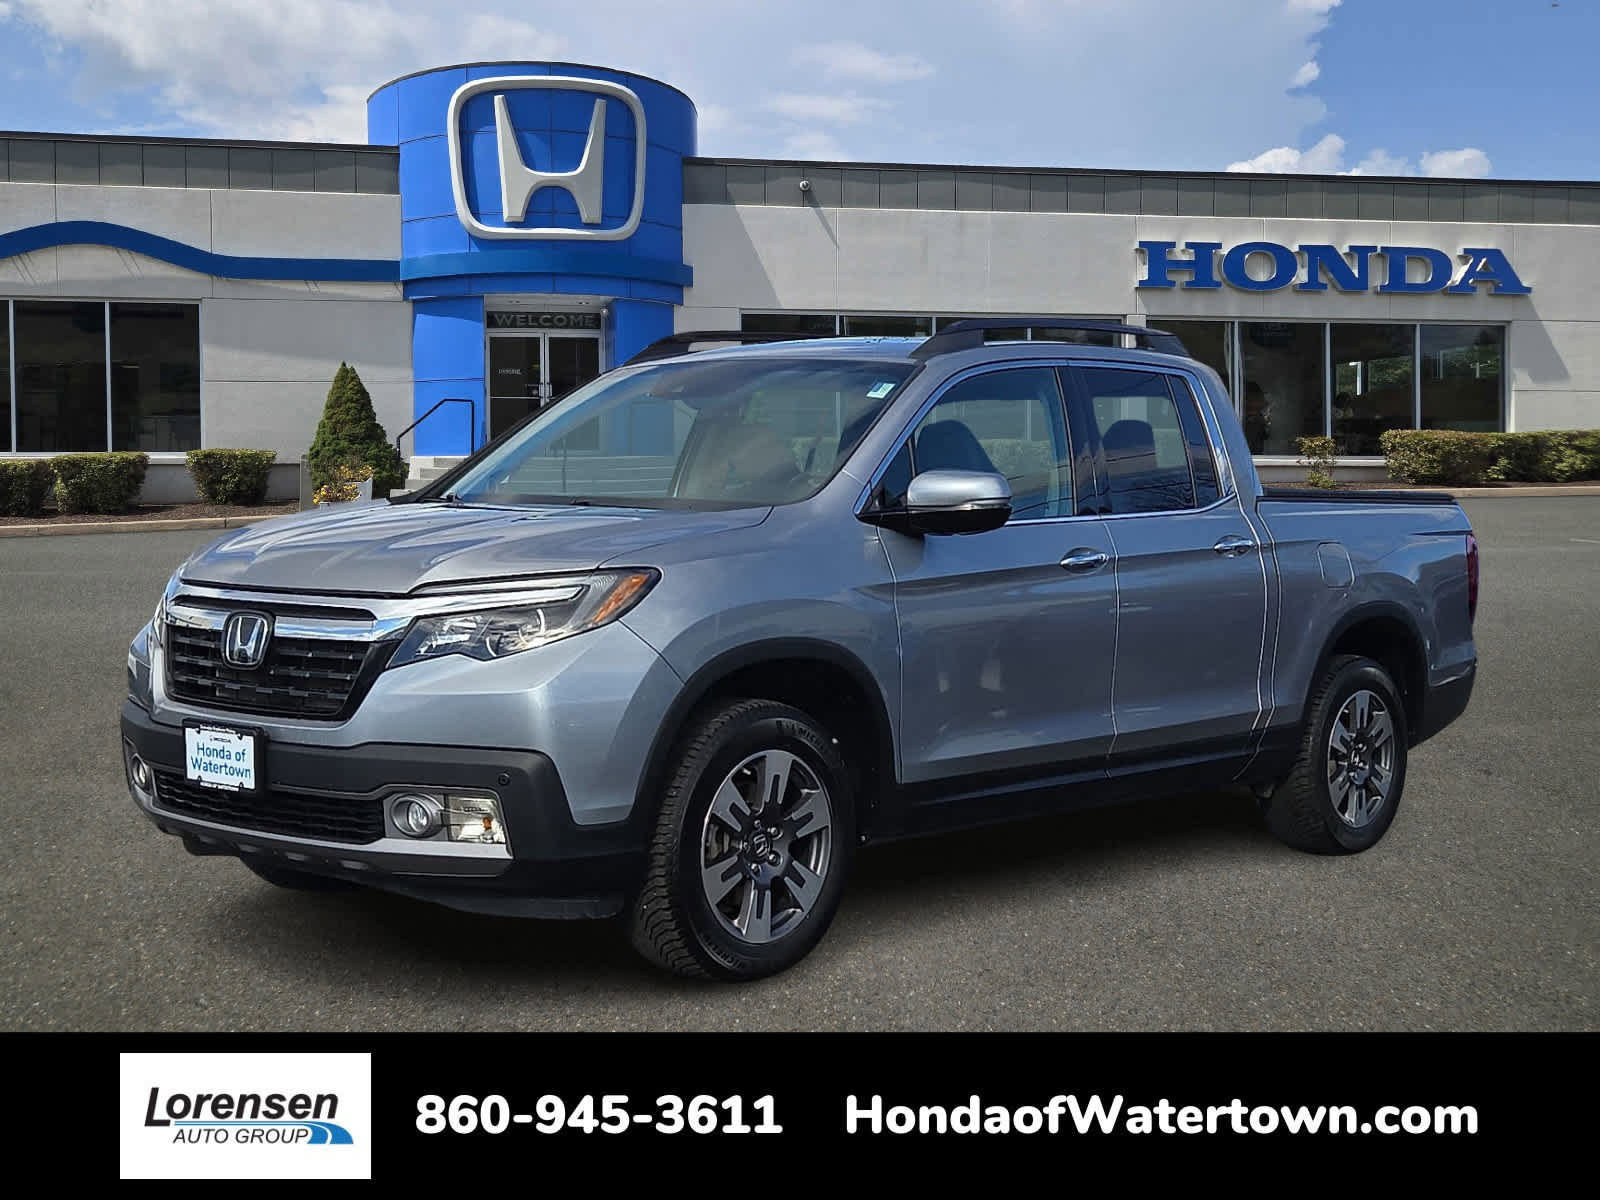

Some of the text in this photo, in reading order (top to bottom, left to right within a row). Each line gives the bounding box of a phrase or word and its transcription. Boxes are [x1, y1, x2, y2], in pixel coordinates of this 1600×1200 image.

[1136, 240, 1533, 296] HONDA
[494, 313, 596, 328] WELCOME
[196, 742, 247, 763] Honda of
[191, 755, 252, 779] Watertown
